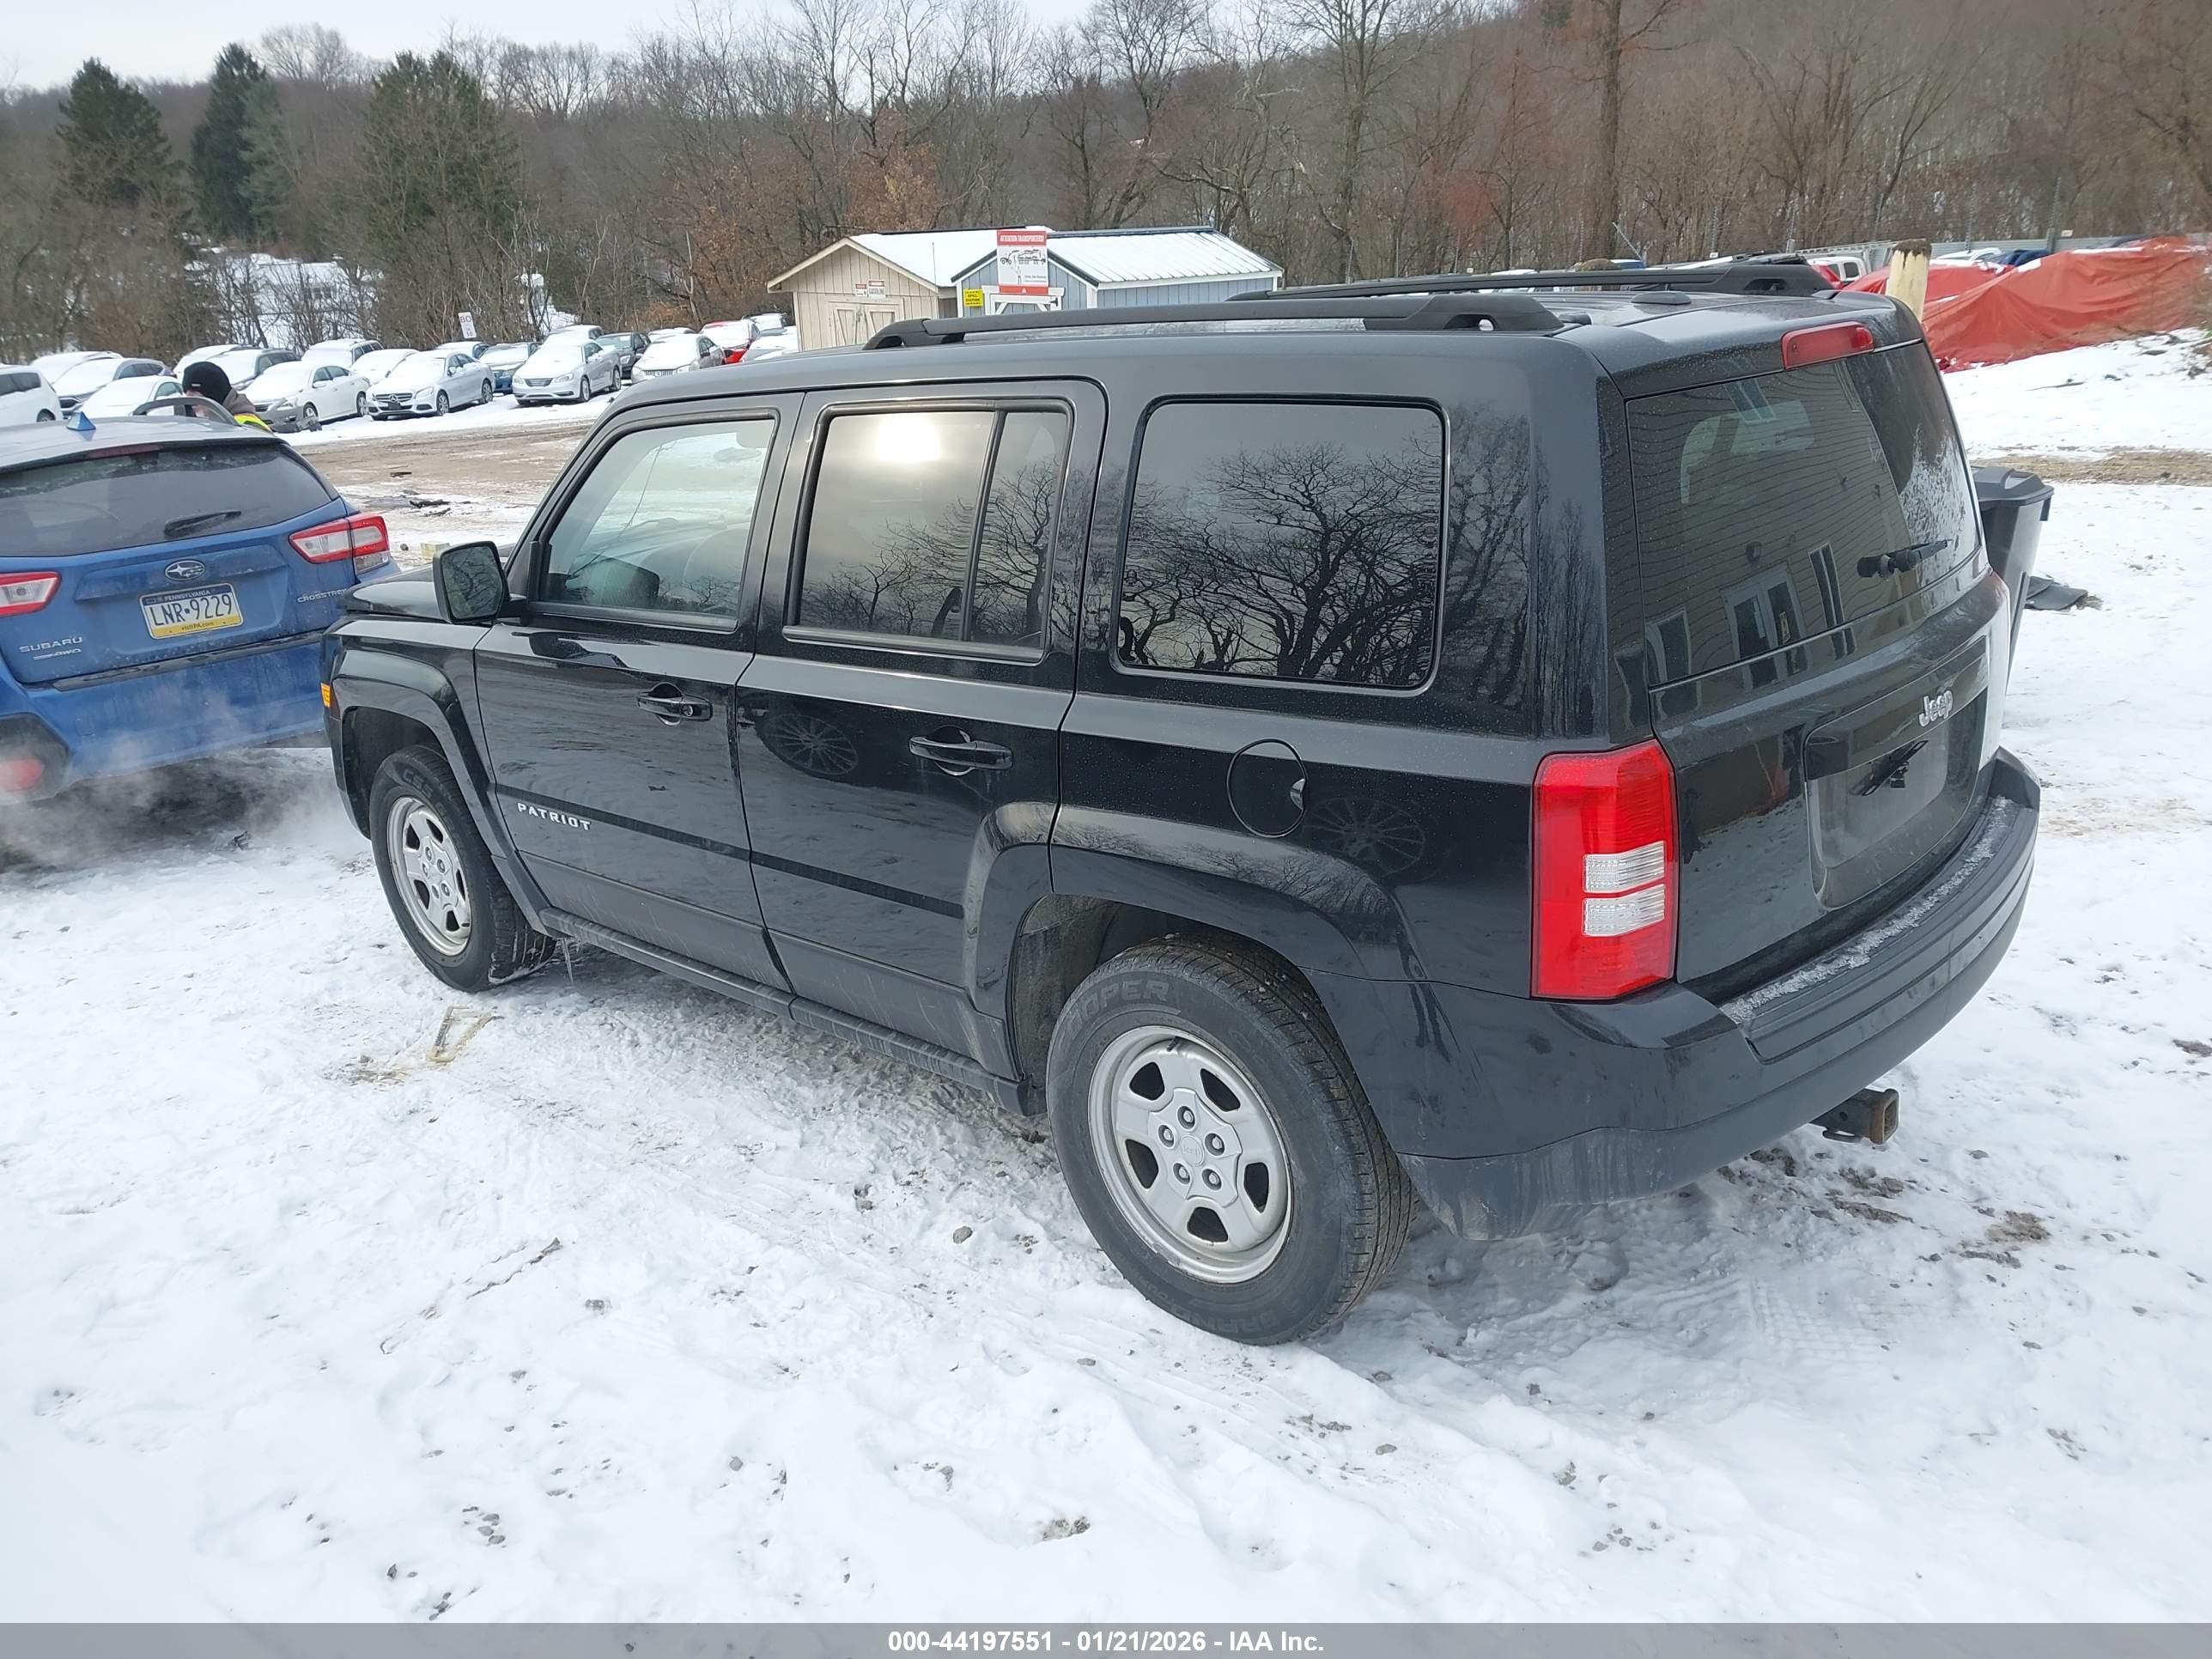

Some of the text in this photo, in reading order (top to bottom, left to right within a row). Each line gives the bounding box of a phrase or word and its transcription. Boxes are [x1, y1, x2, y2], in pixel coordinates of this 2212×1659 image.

[164, 589, 210, 602] PENNSYLVANIA
[19, 636, 82, 653] SUBARU
[1918, 690, 1953, 727] Jeep
[517, 802, 591, 831] PATRIOT
